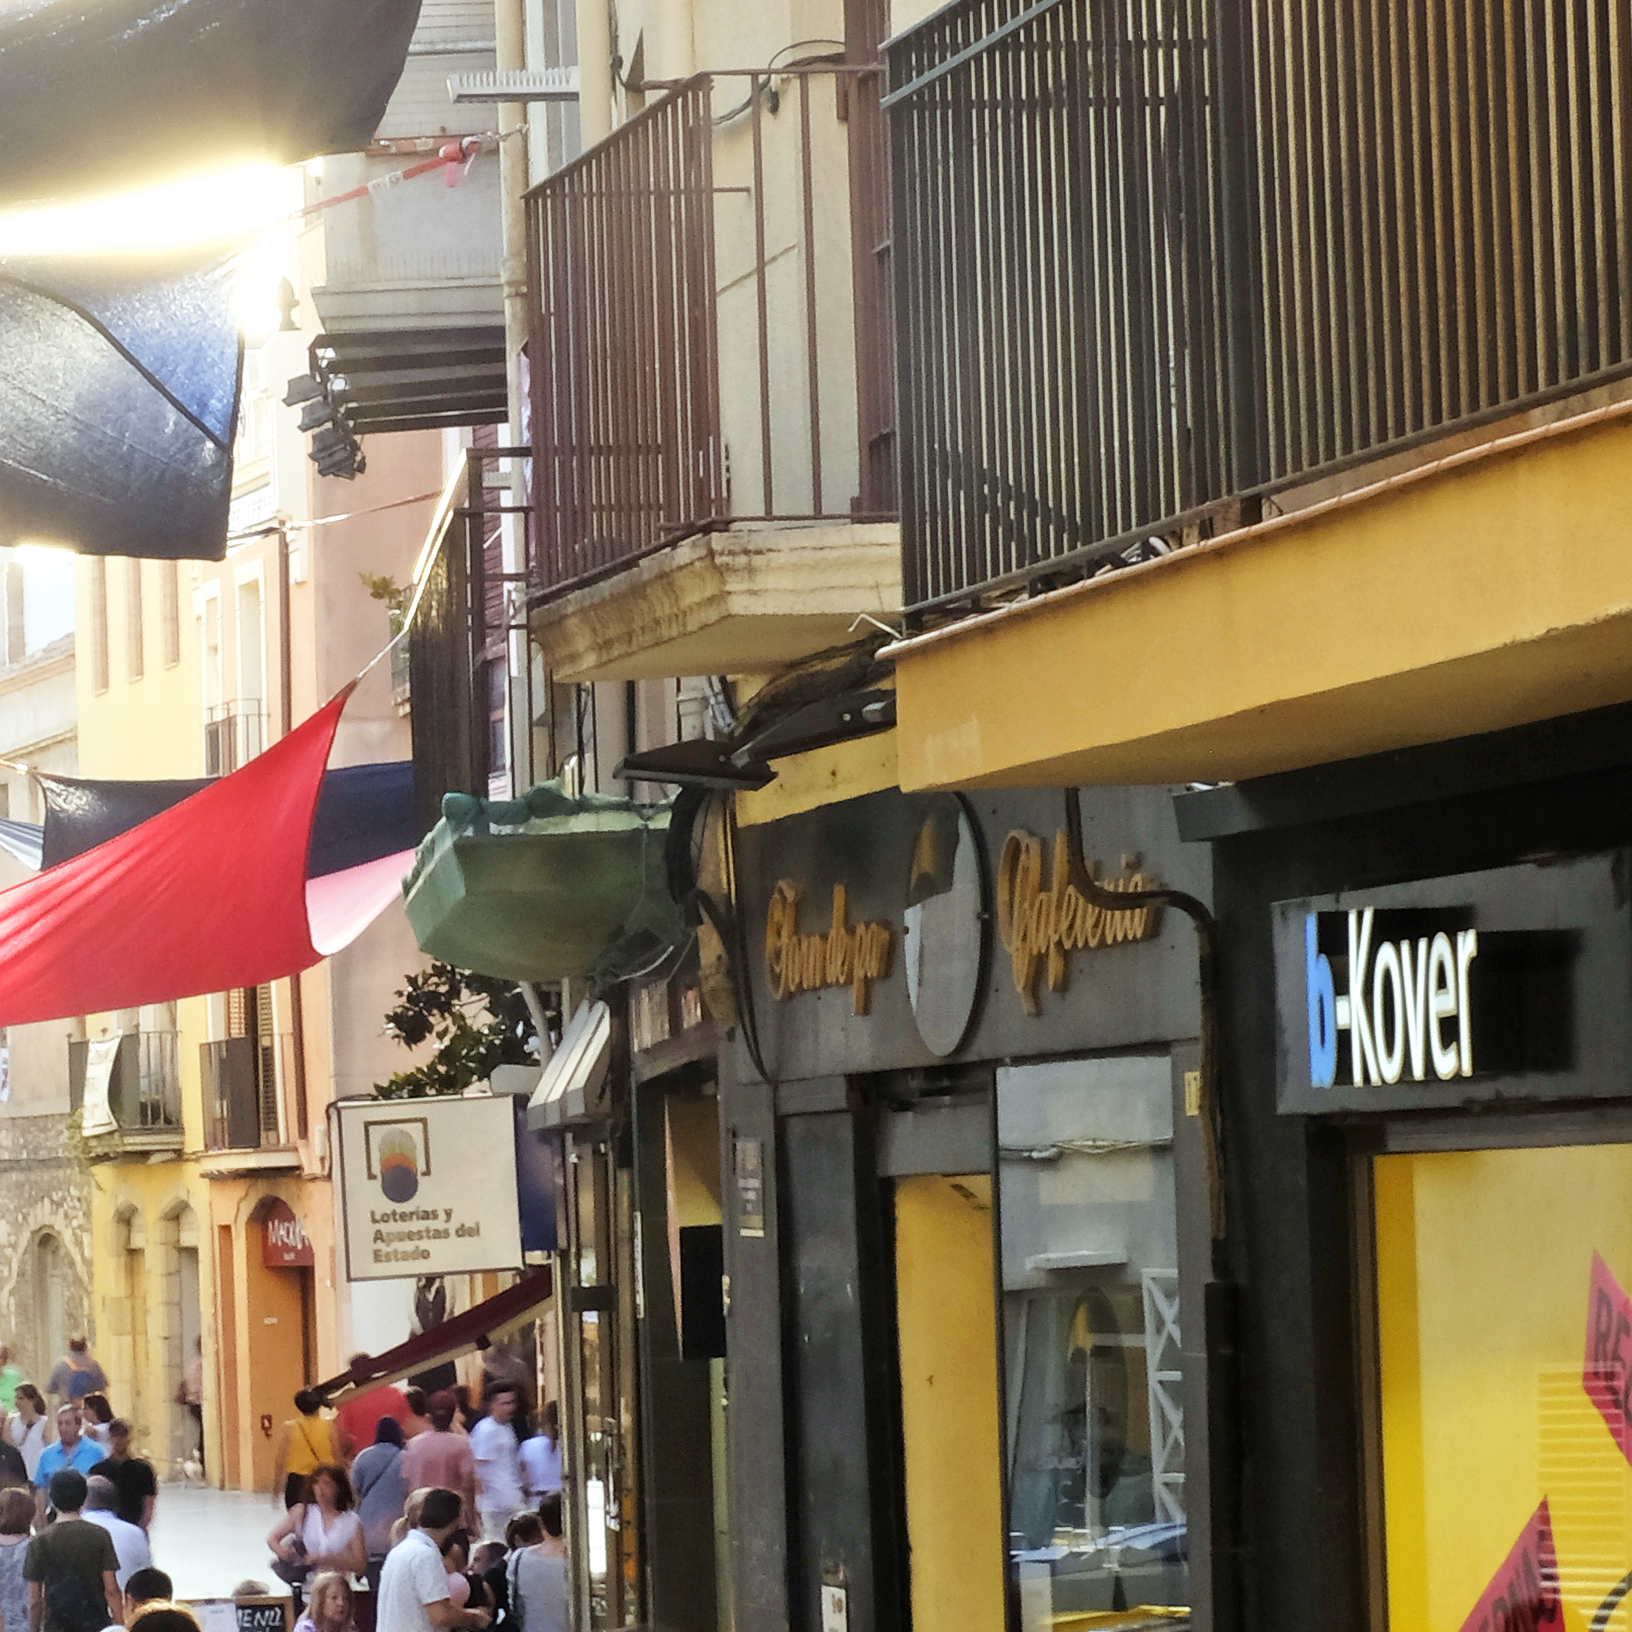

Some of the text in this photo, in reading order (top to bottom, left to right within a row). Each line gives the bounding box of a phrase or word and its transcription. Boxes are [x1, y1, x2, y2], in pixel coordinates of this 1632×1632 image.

[443, 1208, 453, 1223] y
[373, 1221, 480, 1246] Apuestas del
[373, 1245, 430, 1263] Estado
